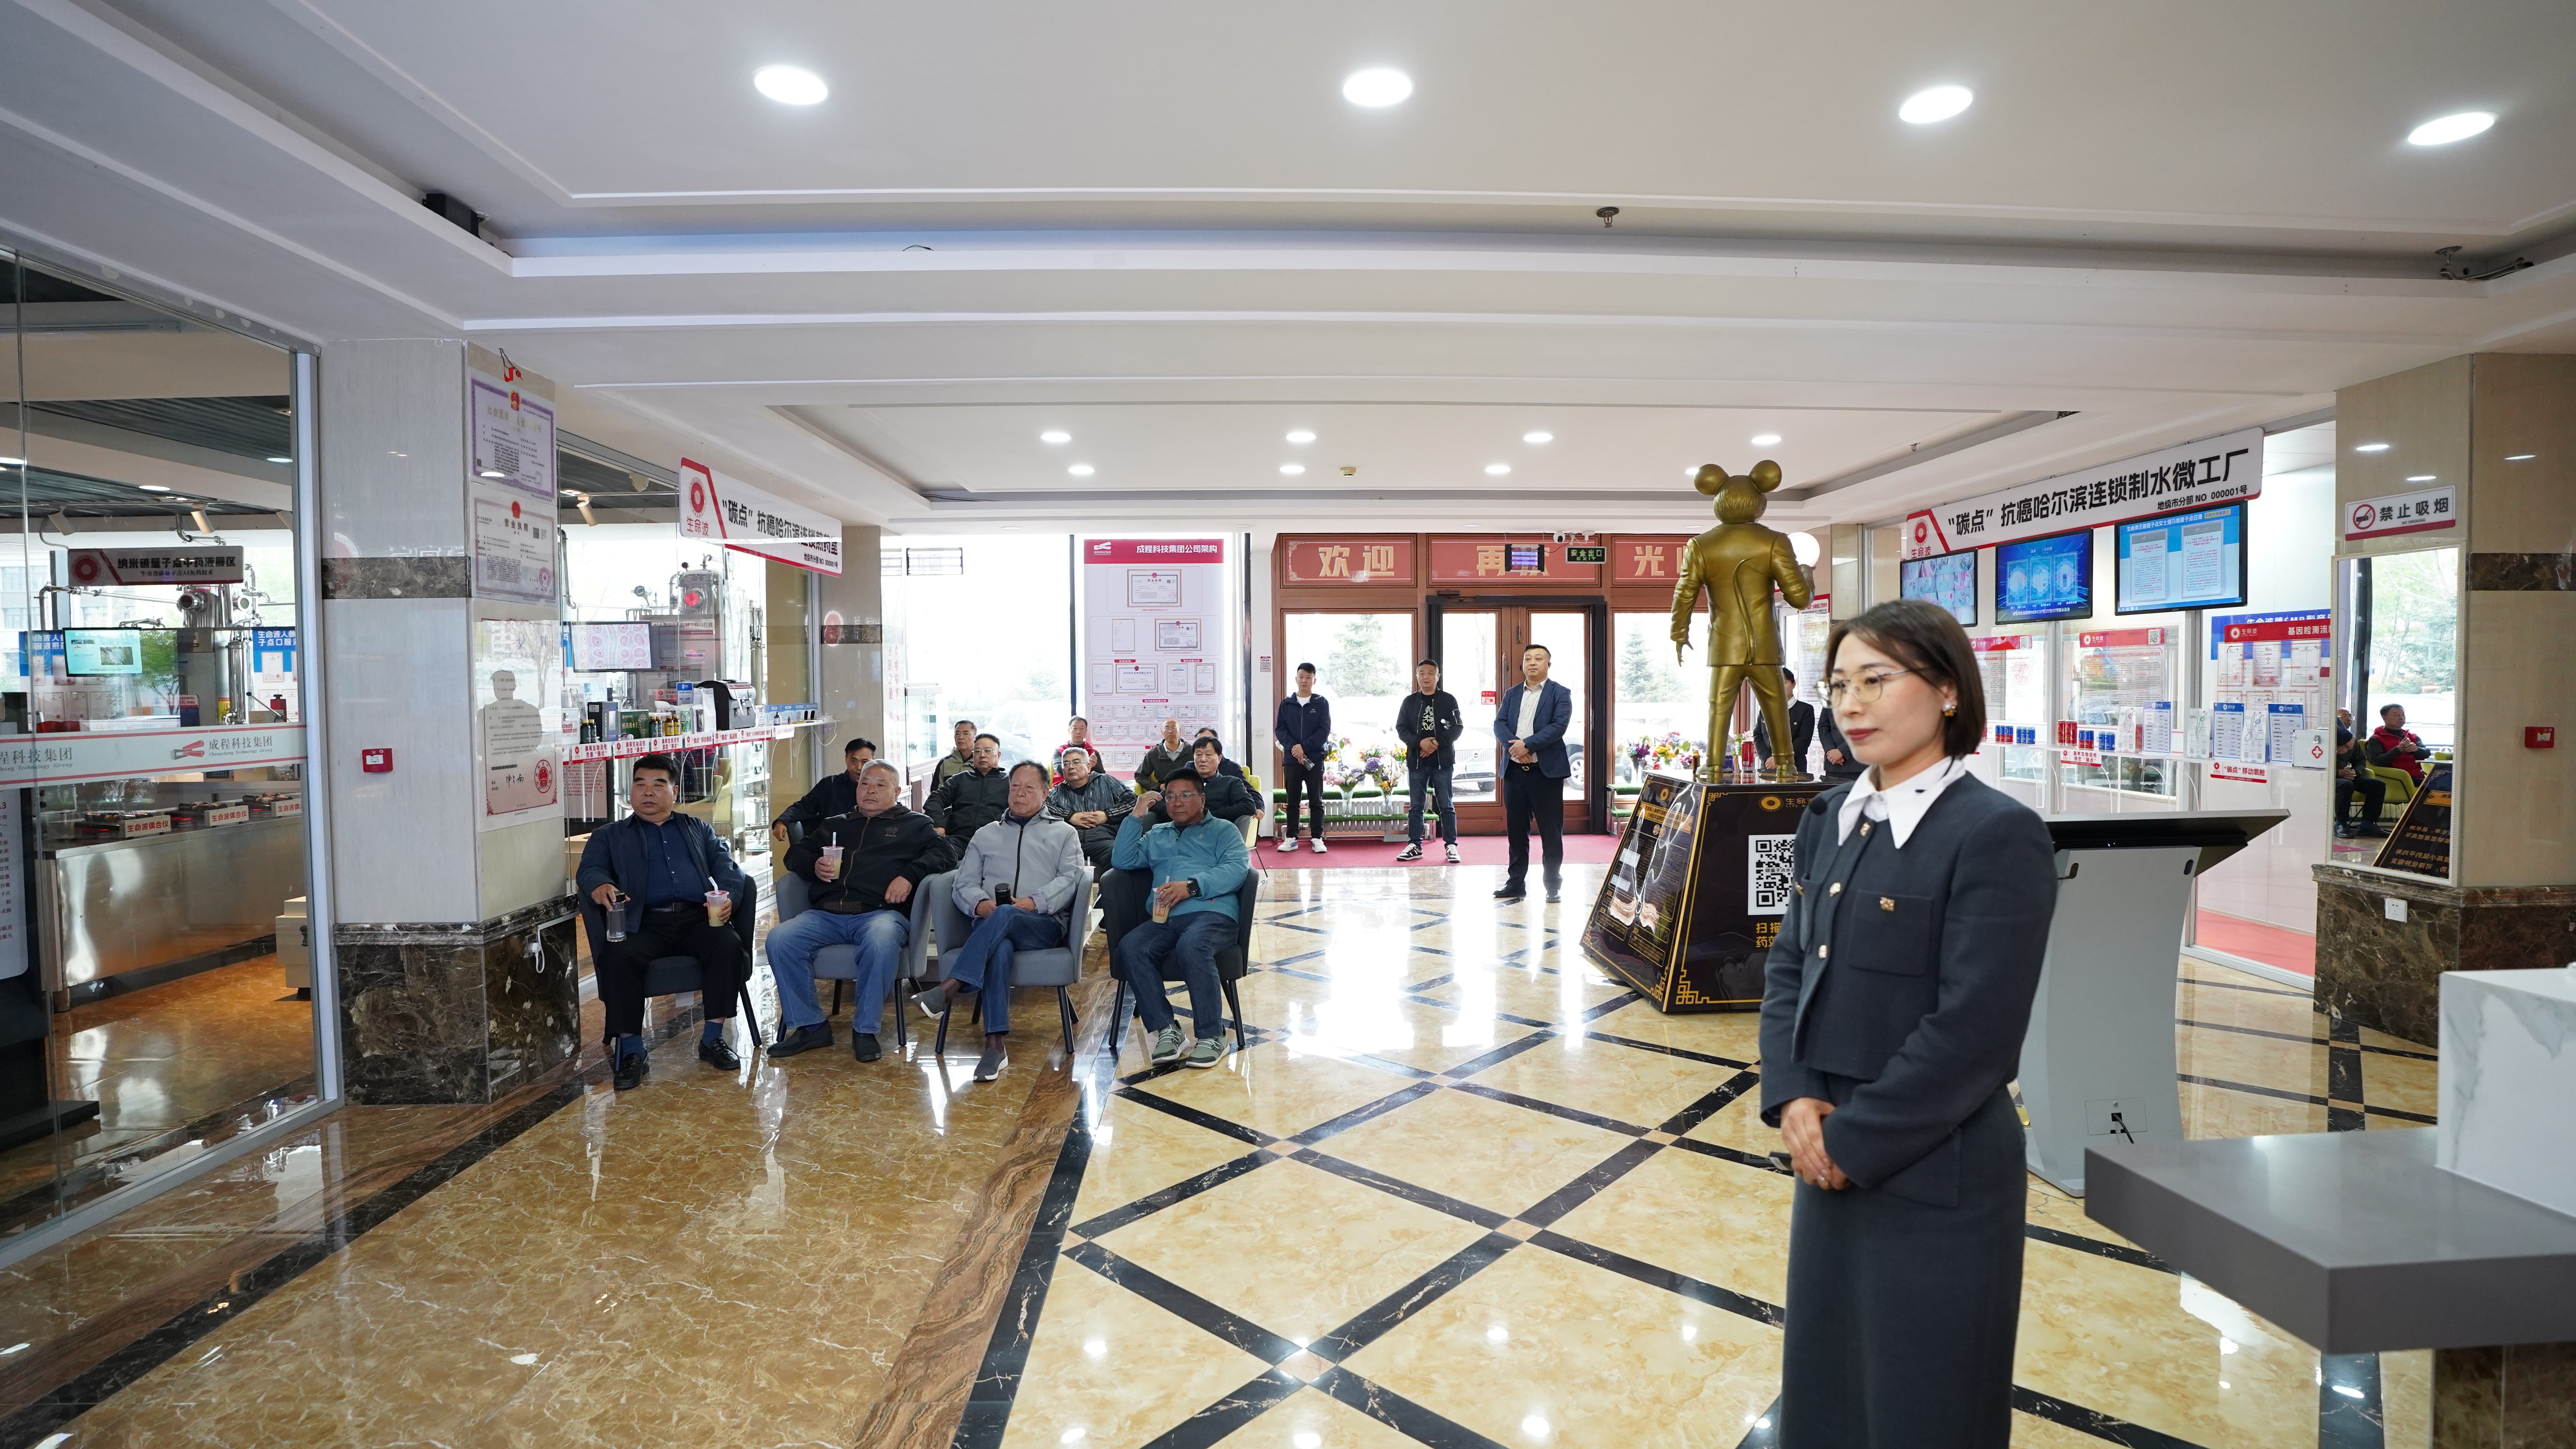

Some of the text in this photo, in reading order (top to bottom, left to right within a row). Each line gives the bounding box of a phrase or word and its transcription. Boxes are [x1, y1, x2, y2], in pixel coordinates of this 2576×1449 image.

[2157, 485, 2248, 510] 地级市分部 NO 000001号
[2380, 498, 2448, 521] 禁止吸烟
[504, 518, 528, 531] 营业执照
[687, 516, 708, 536] 生命波
[1137, 545, 1217, 553] 成程科技集团公司架构
[1911, 546, 1931, 557] 生命波
[1318, 545, 1394, 577] 欢迎
[210, 736, 272, 750] 成程科技集团
